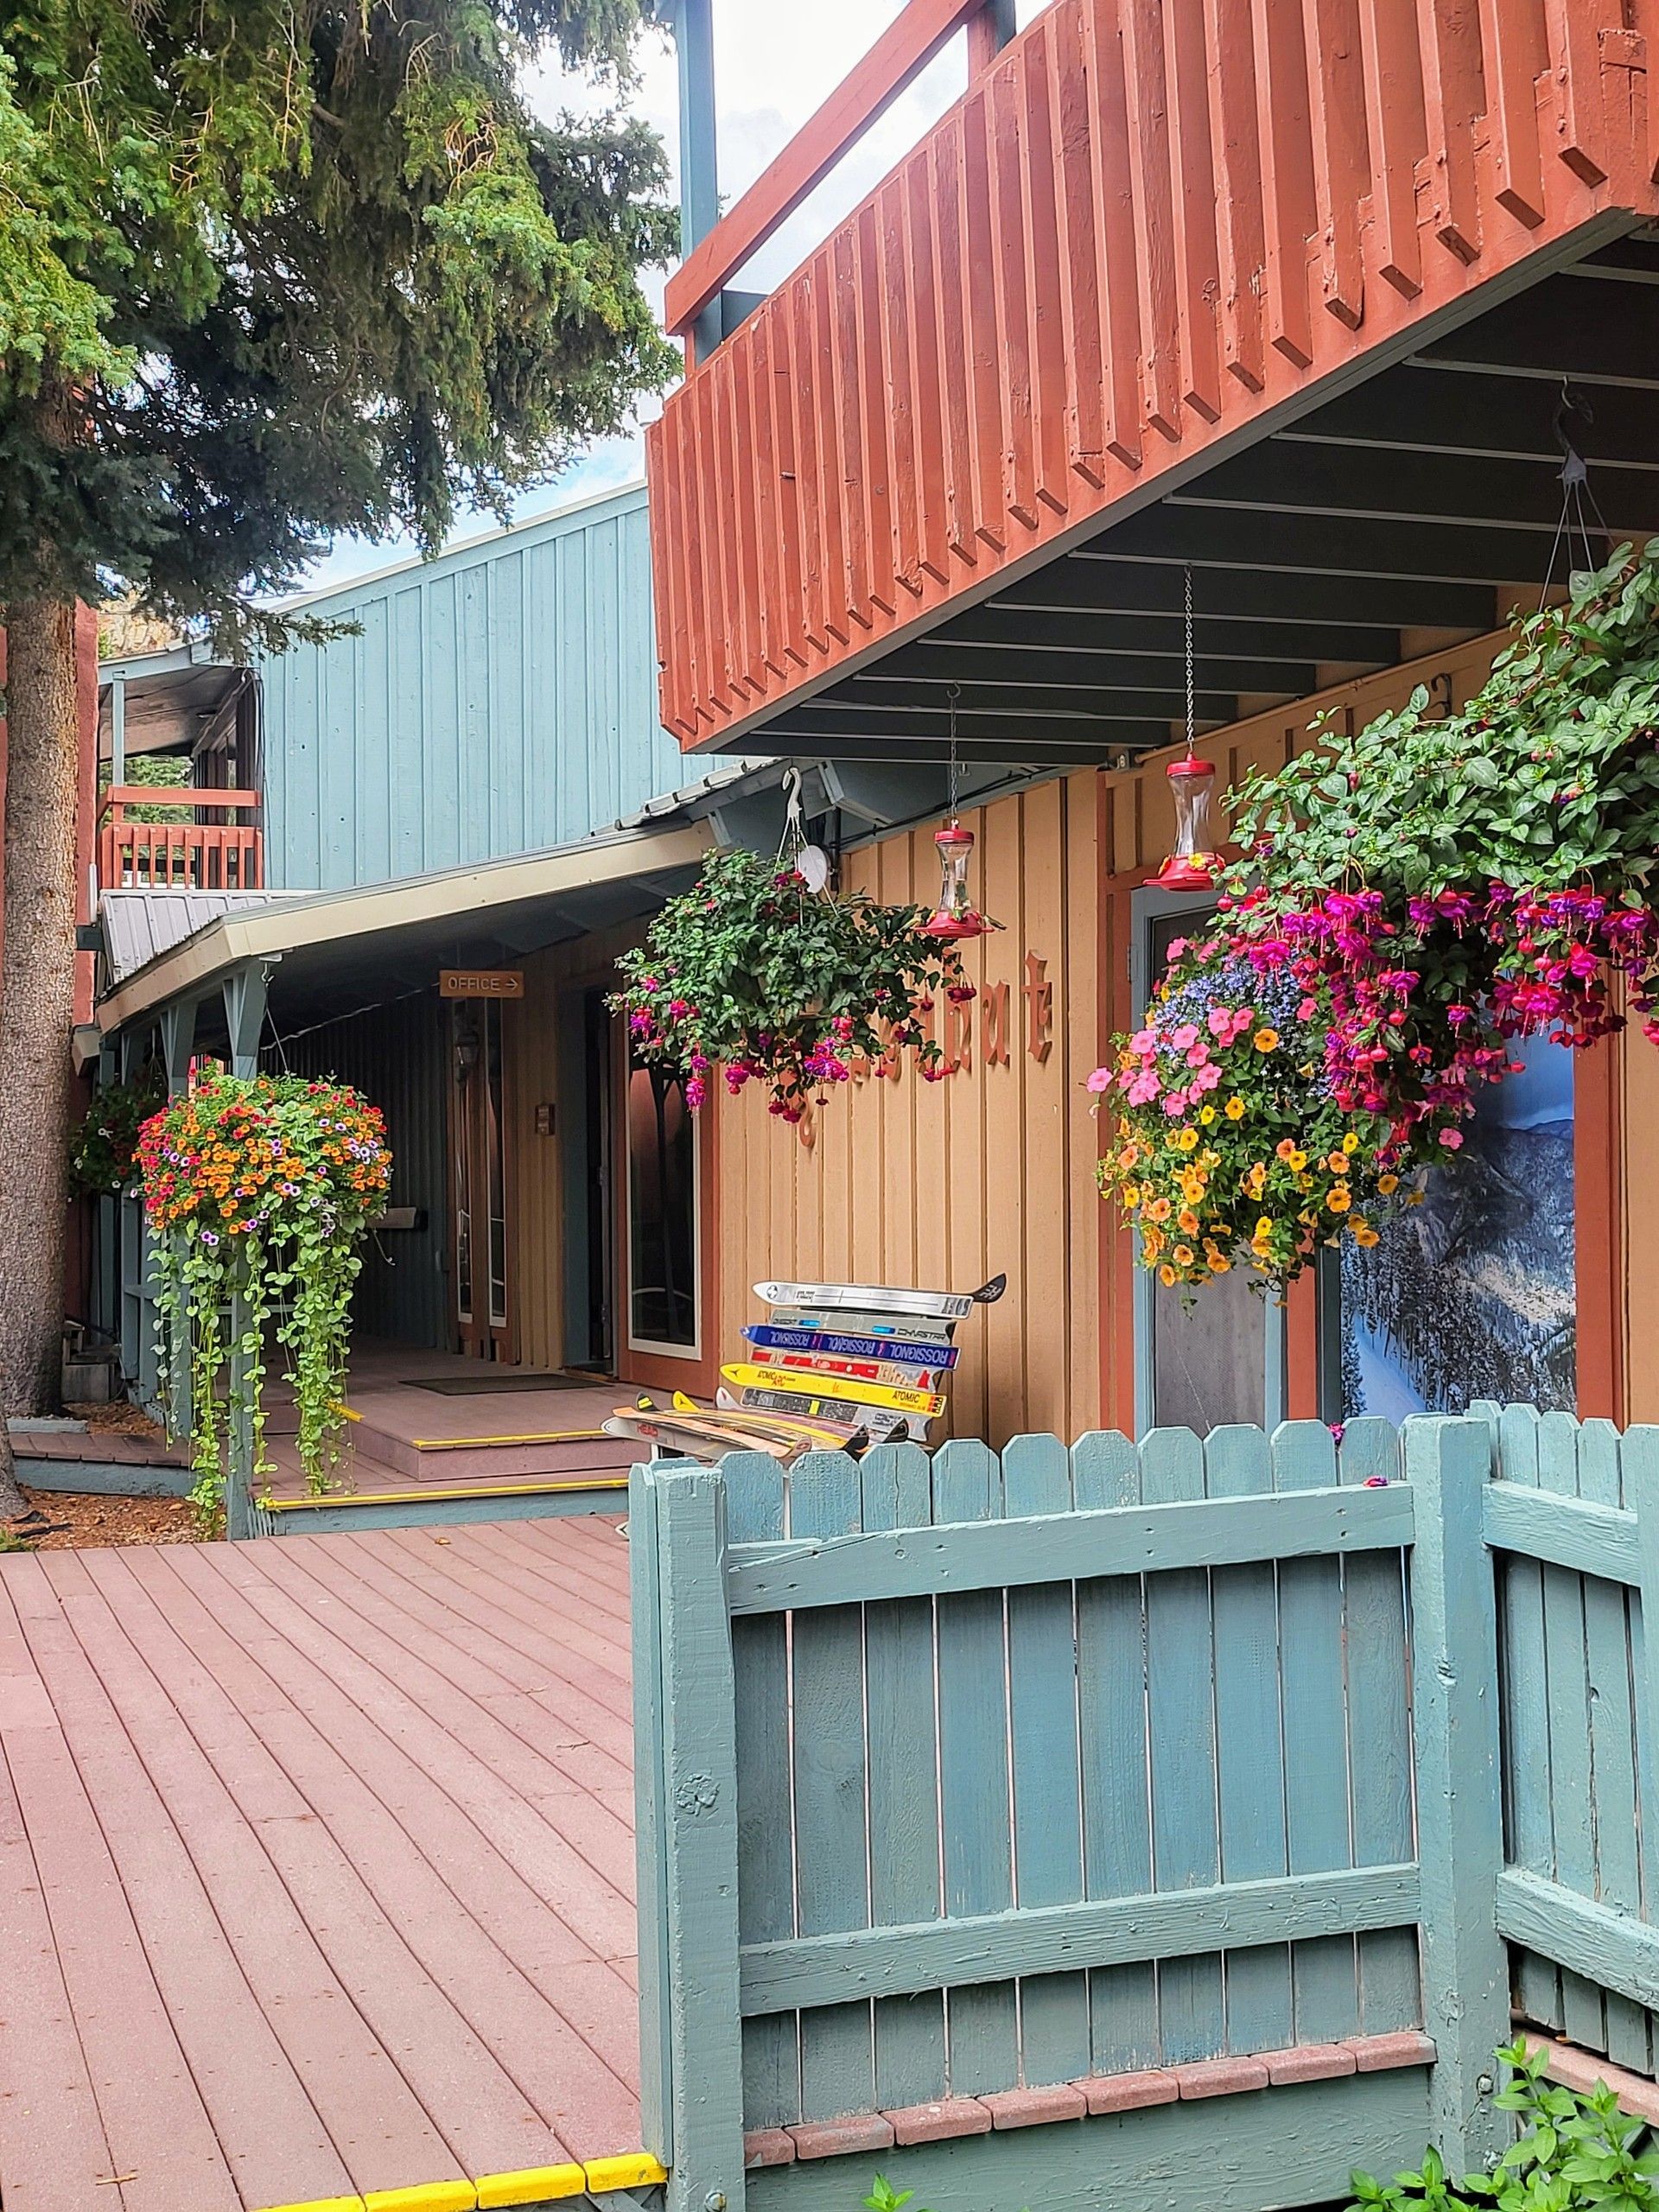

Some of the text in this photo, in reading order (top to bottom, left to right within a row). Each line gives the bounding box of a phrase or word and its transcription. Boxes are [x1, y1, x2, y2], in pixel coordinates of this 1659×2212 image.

[448, 976, 501, 991] OFFICE
[897, 1327, 946, 1341] DYNASTAR
[770, 1331, 949, 1364] ROSSIGNOL ROSSIGNOL ROSSIGNOL
[891, 1389, 921, 1404] ATOMIC
